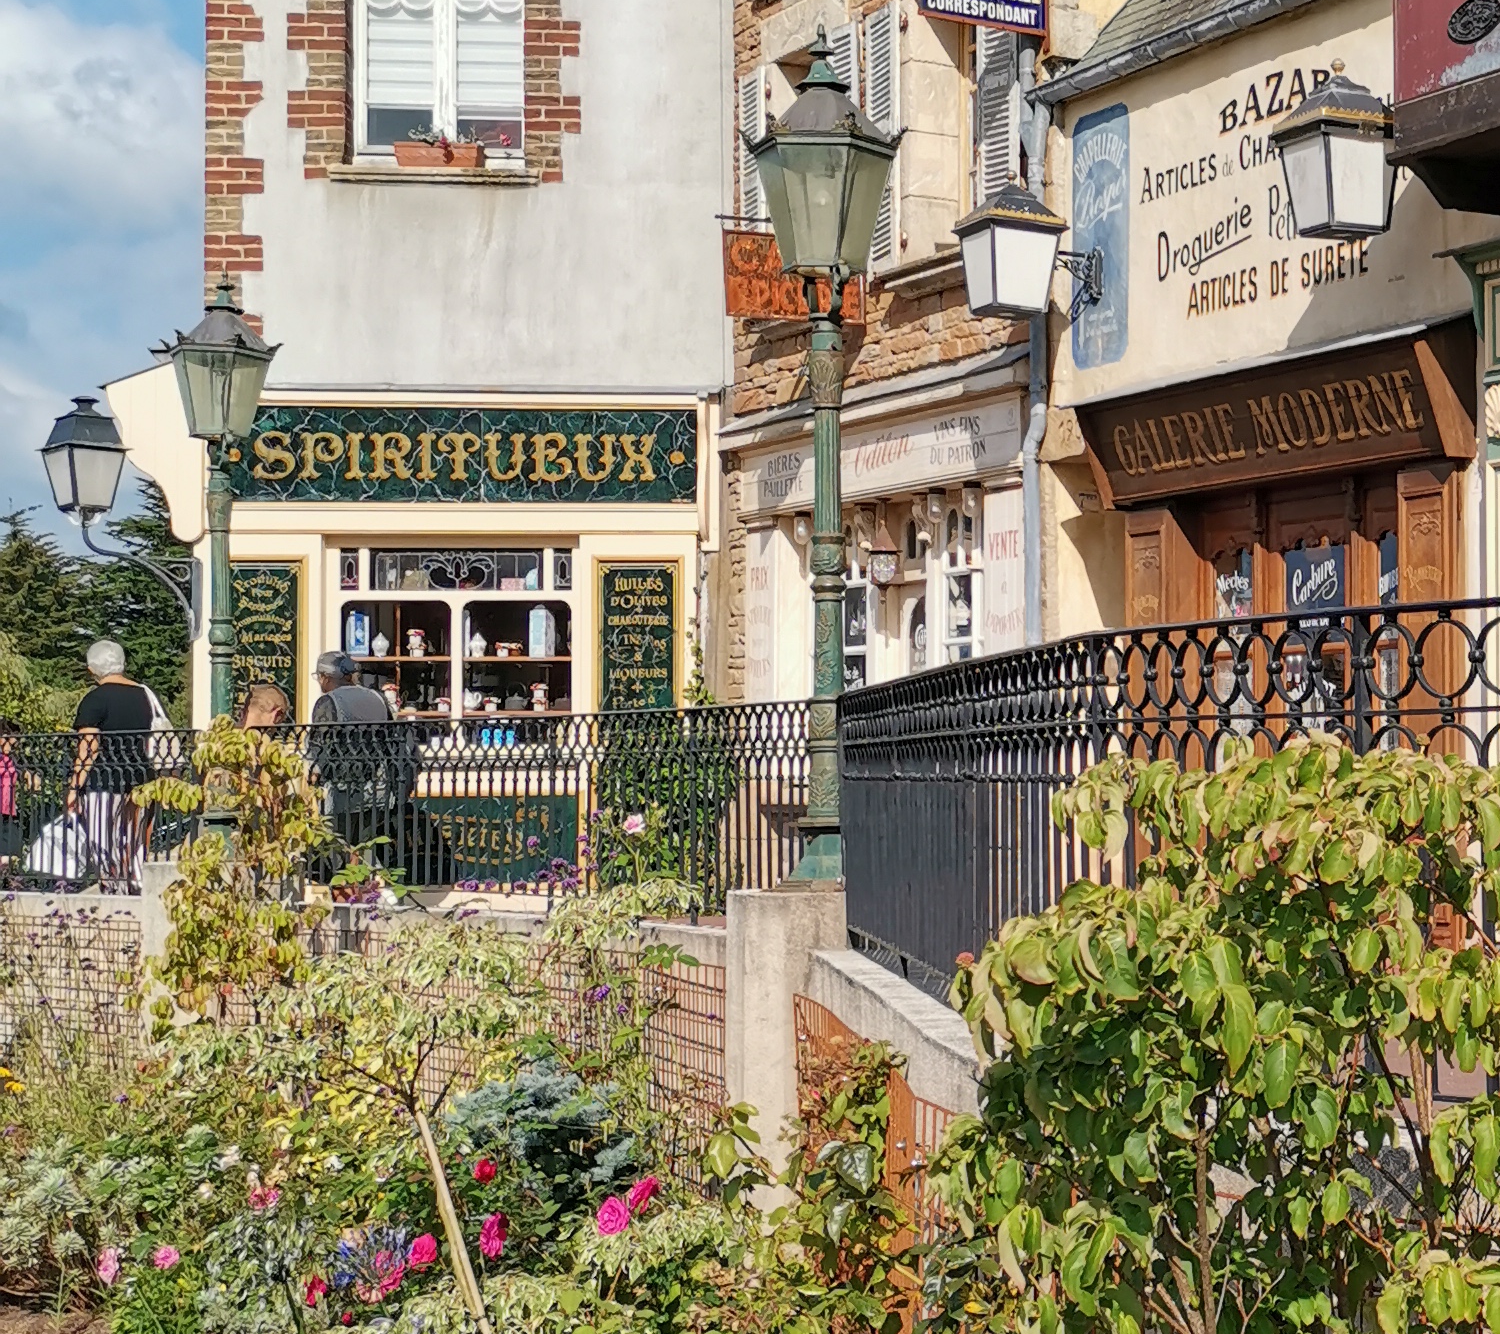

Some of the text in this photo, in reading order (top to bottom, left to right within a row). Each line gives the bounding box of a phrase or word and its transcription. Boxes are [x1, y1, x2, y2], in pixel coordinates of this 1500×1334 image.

[1074, 132, 1127, 184] CHAPELLERIE
[1139, 153, 1218, 205] ARTICLES
[1222, 153, 1234, 178] de
[1157, 196, 1252, 282] Droguerie
[1186, 266, 1257, 320] ARTICLES
[1270, 257, 1289, 299] DE
[1112, 369, 1424, 476] GALERIE MODERNE
[253, 431, 658, 482] SPIRITUEUX
[767, 451, 801, 478] BIERES
[929, 446, 944, 466] DU
[947, 438, 987, 466] PATRON
[988, 530, 1019, 561] VENTE
[1292, 558, 1338, 605] Carbure
